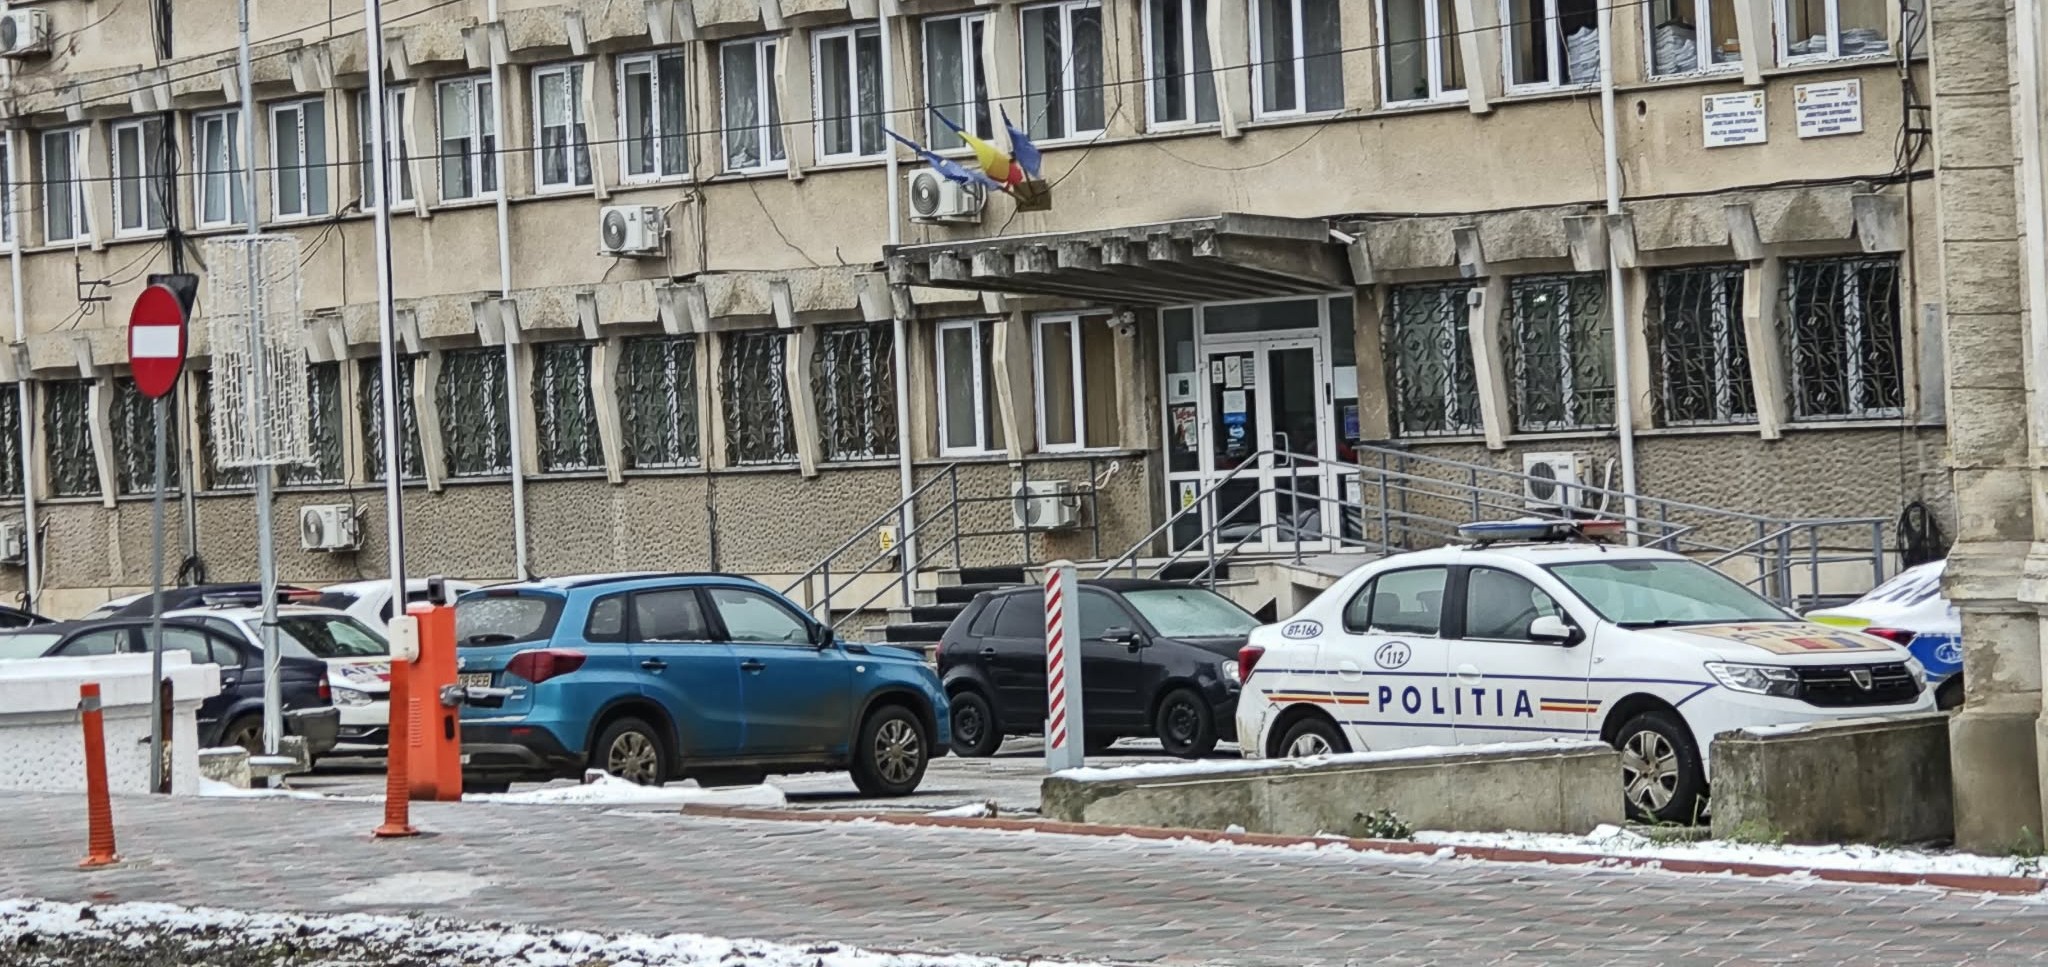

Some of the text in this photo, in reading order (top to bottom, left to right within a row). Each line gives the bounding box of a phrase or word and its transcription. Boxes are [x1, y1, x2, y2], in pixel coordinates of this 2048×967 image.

[1287, 624, 1318, 636] BT-166
[1386, 651, 1404, 664] 112
[1378, 685, 1534, 718] POLITIA
